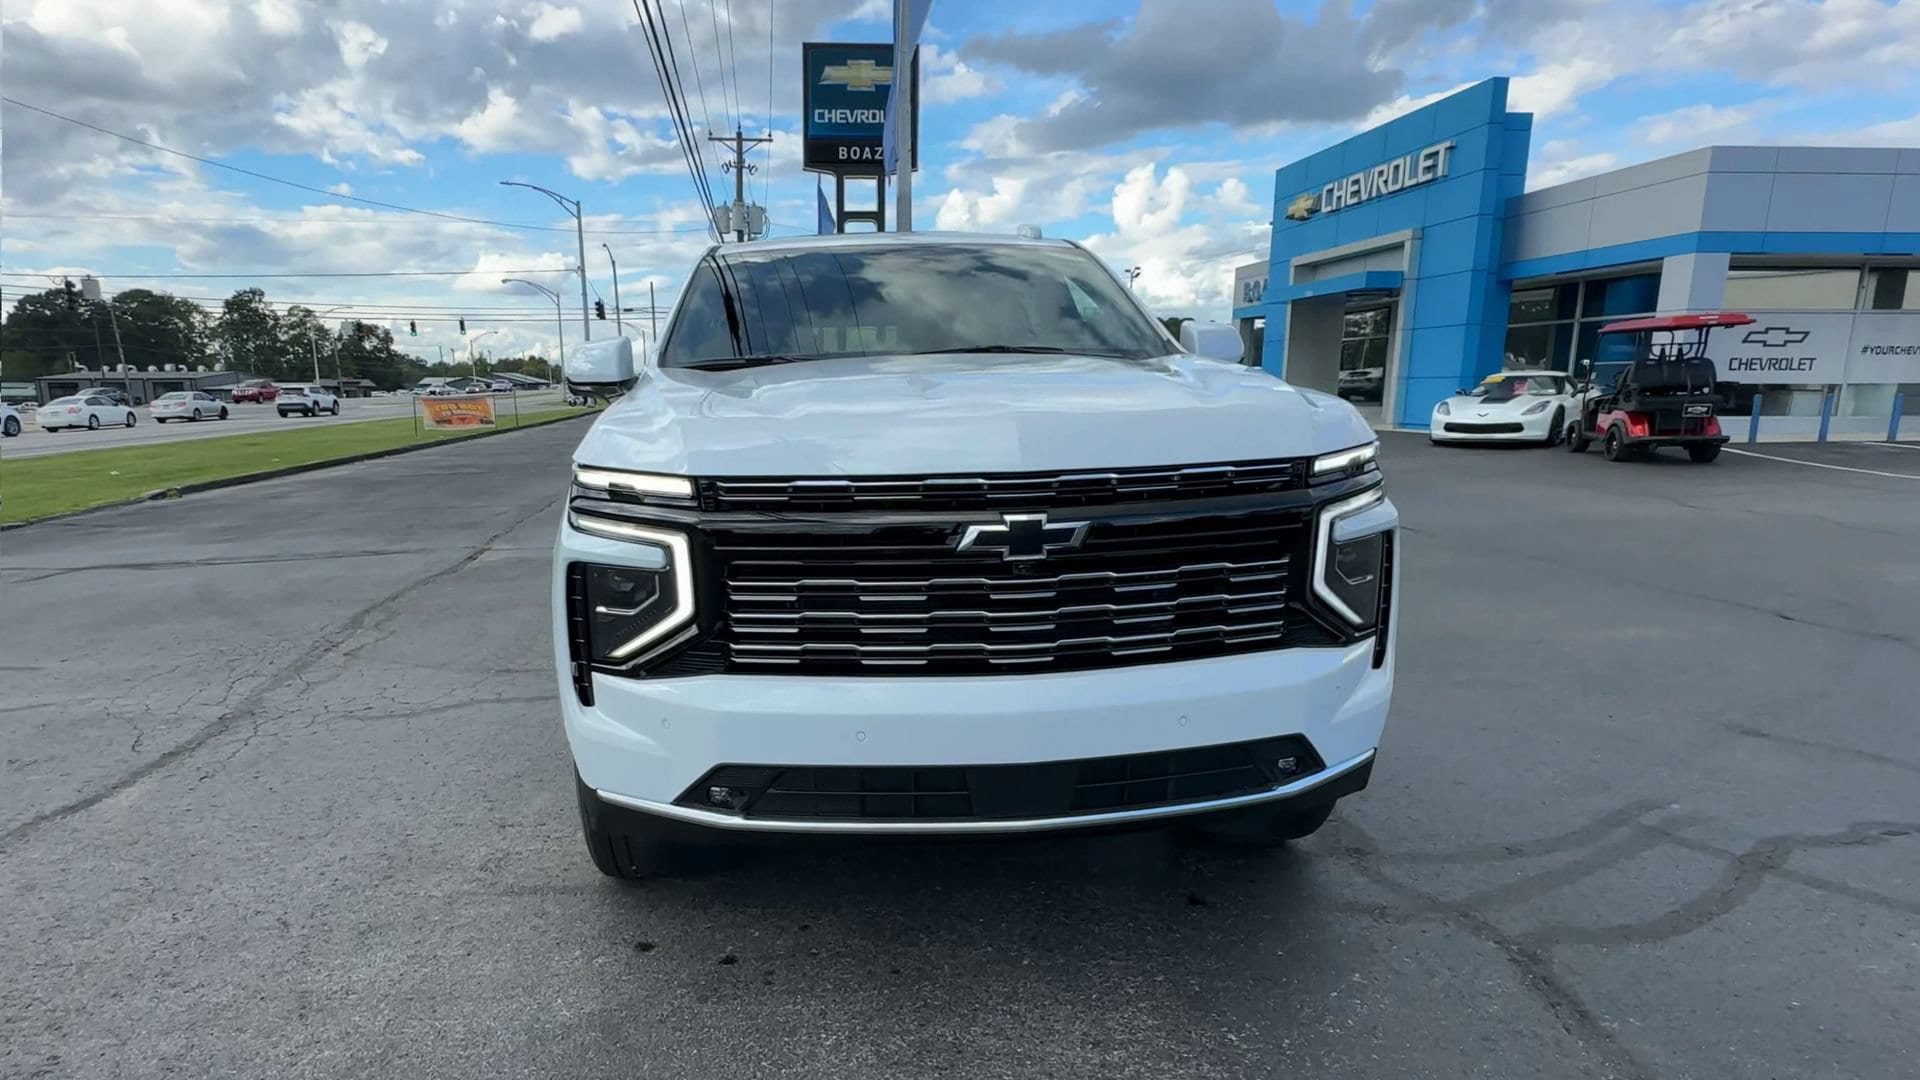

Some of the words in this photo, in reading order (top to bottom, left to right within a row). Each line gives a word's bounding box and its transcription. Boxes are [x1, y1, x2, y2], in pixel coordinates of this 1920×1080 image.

[814, 109, 886, 124] CHEVROL
[838, 146, 884, 160] BOAZ
[1320, 140, 1456, 214] CHEVROLET
[1728, 357, 1817, 371] CHEVROLET
